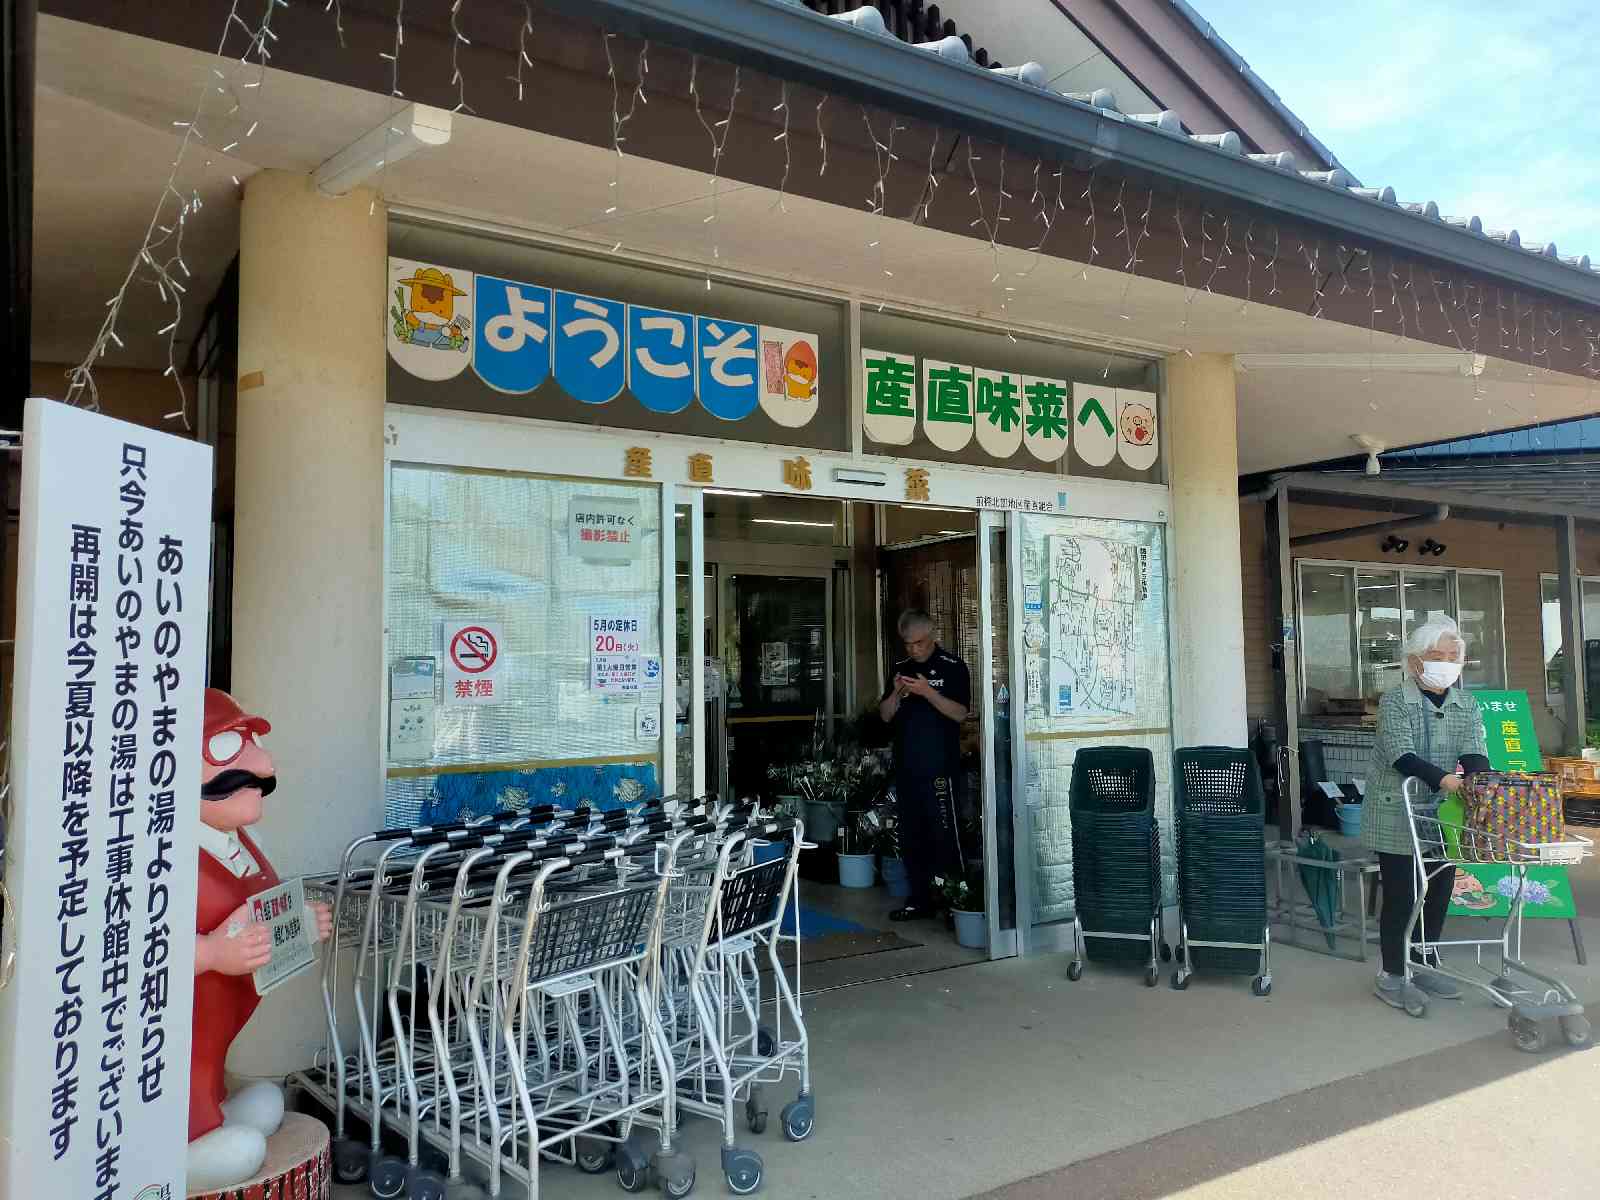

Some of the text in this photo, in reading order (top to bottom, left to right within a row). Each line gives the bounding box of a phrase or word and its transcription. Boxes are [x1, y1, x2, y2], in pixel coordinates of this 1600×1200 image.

[484, 286, 756, 387] ようこそ
[865, 356, 1115, 440] 産直味菜へ
[575, 513, 635, 527] 店内許可なく
[455, 680, 494, 698] 禁煙
[49, 523, 102, 1161] 再開は今夏以降を予定しております
[137, 534, 184, 1104] あいのやまの湯よりお知らせ
